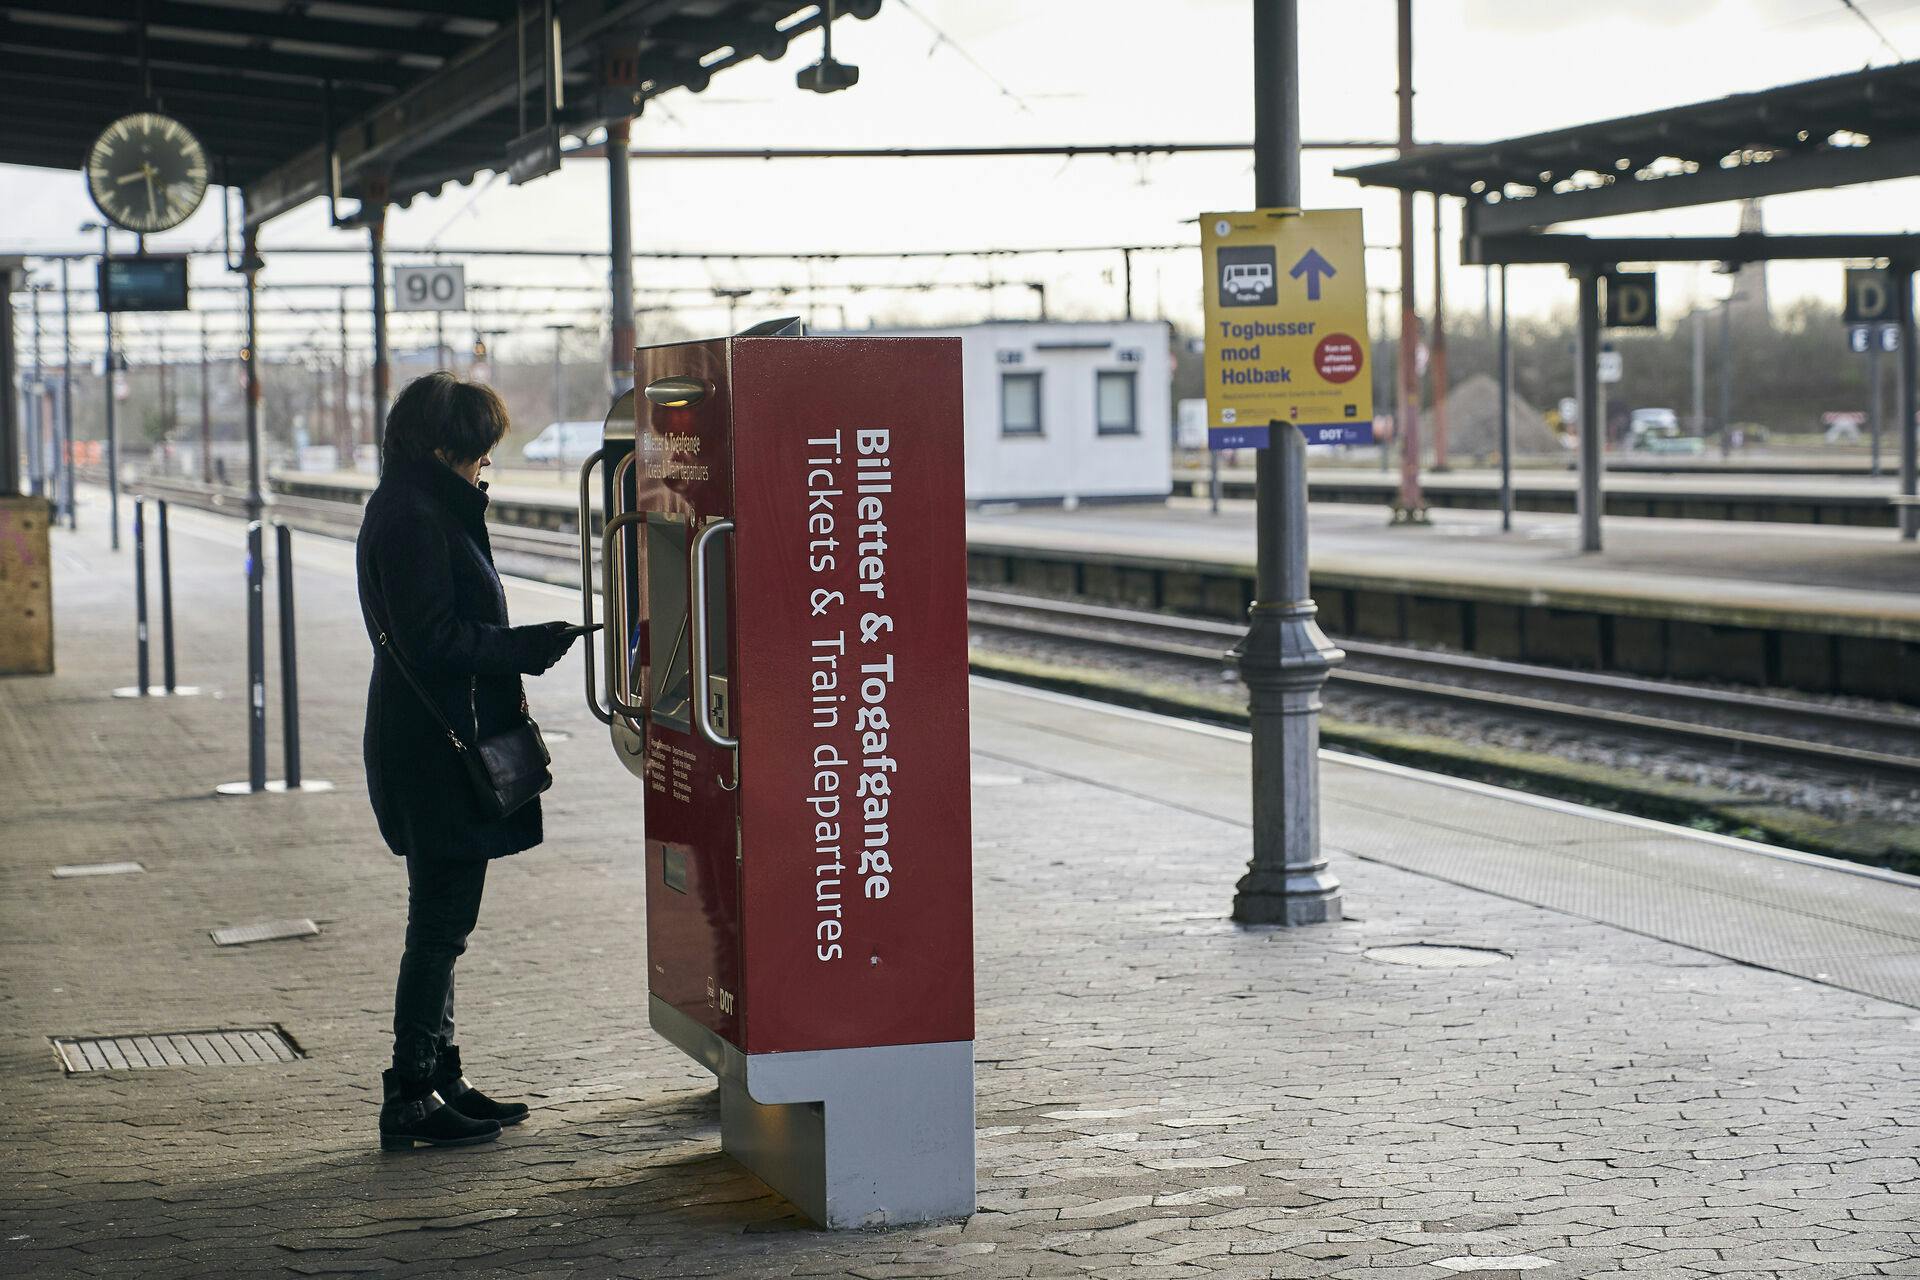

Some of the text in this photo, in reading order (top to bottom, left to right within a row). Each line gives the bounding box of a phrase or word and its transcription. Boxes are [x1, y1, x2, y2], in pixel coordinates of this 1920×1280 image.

[406, 273, 454, 303] 90
[1855, 278, 1886, 318] D
[1618, 285, 1648, 322] D
[1220, 321, 1316, 340] Togbusser
[1221, 345, 1261, 361] mod
[1222, 366, 1291, 384] Holbæk
[855, 428, 895, 899] Billetter & Togafgange
[807, 428, 849, 963] Tickets & Train departures
[719, 988, 734, 1016] DOT
